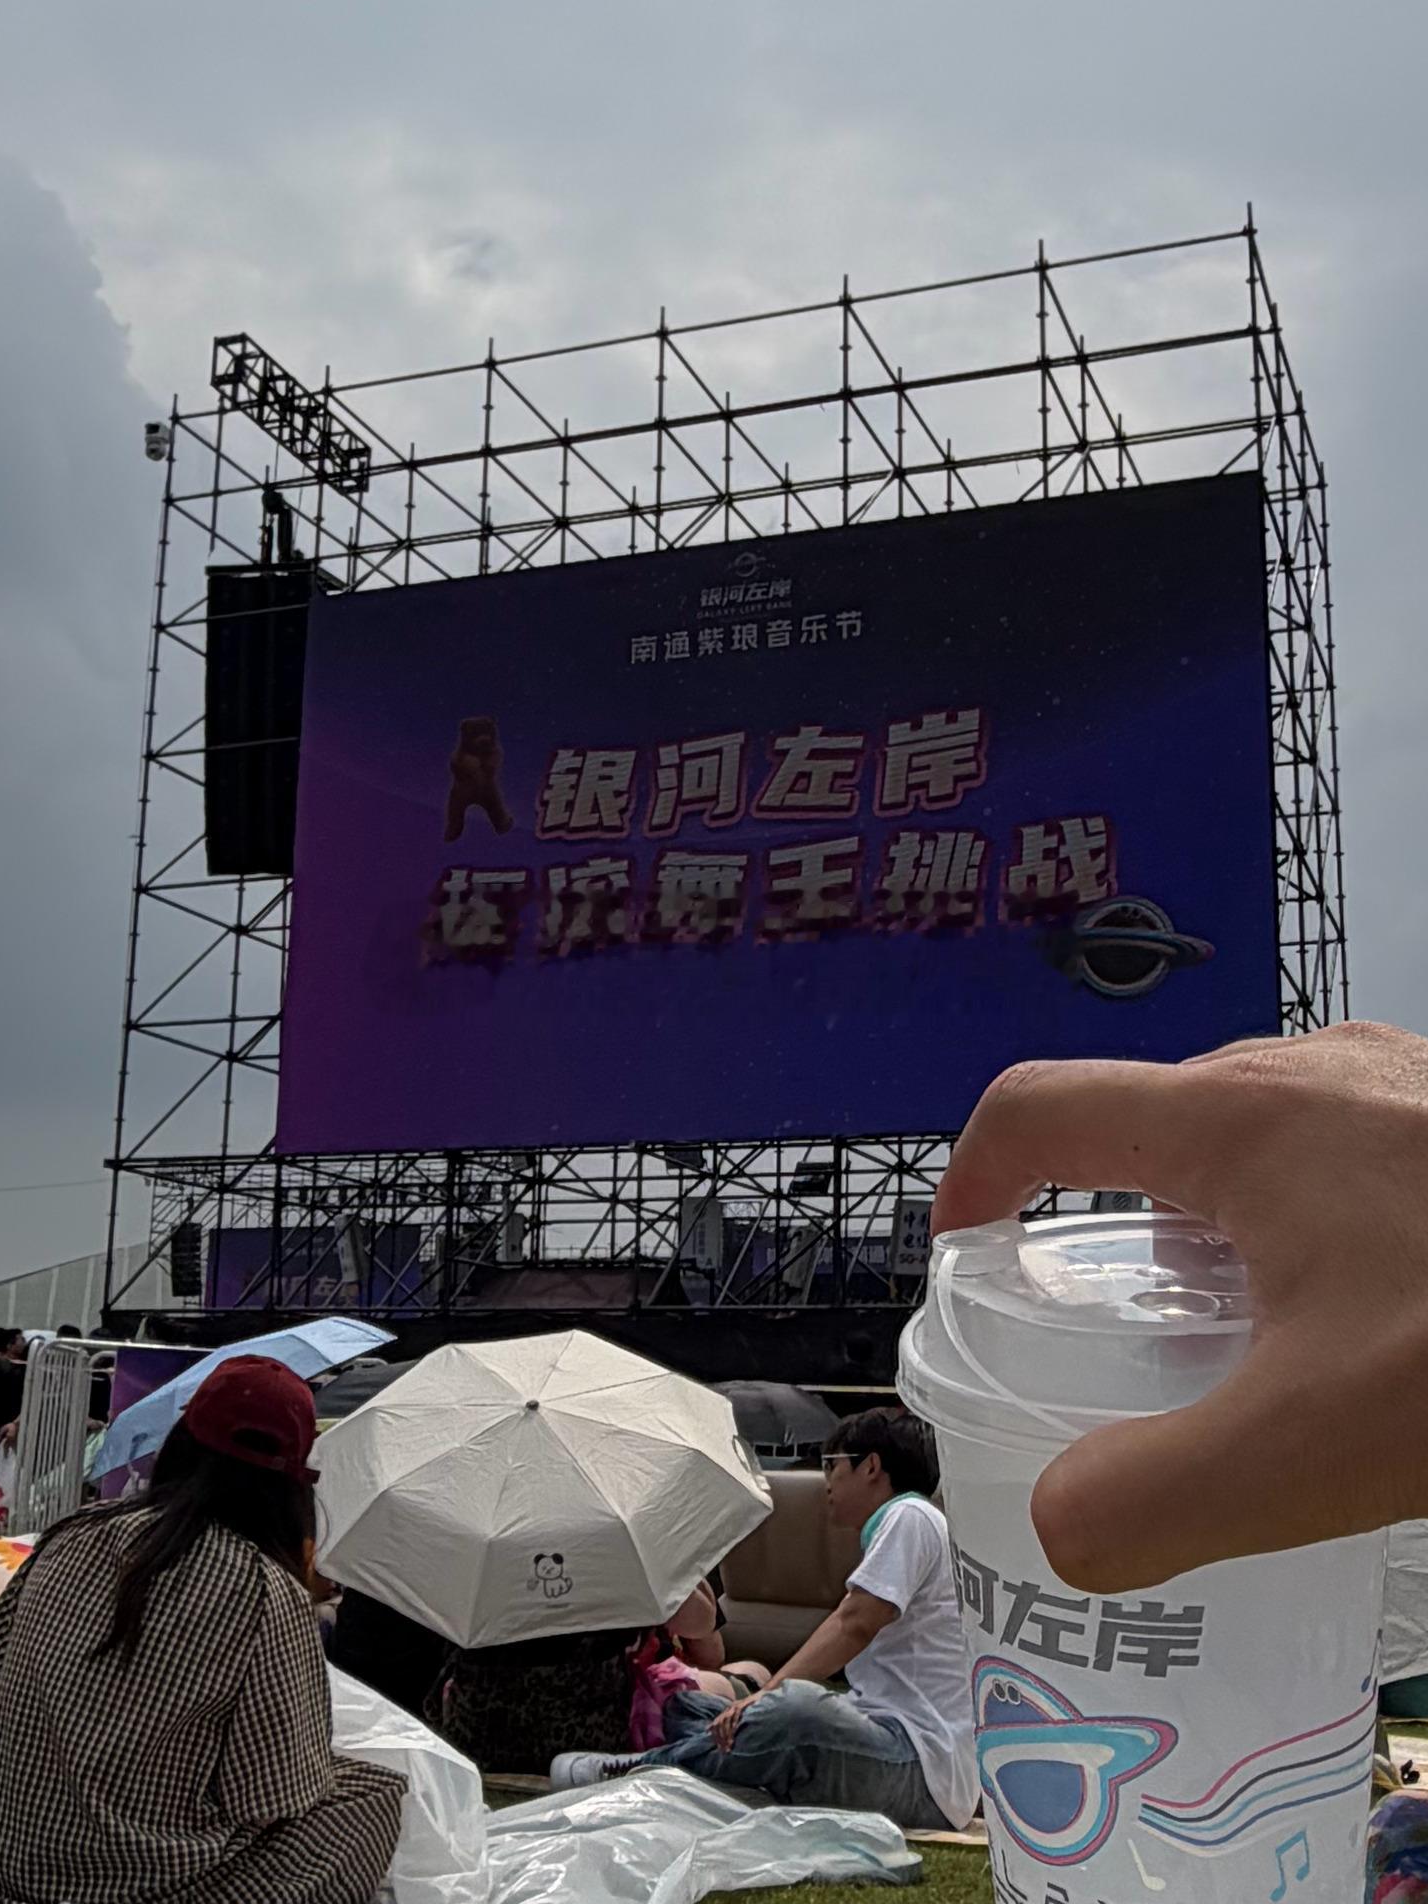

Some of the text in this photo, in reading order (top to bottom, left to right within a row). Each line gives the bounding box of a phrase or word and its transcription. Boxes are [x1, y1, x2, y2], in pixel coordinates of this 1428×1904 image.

[630, 610, 864, 664] 南通紫琅音乐节
[699, 579, 792, 608] 银河左岸
[538, 708, 982, 835] 银河左岸
[952, 1540, 1205, 1678] 河左岸
